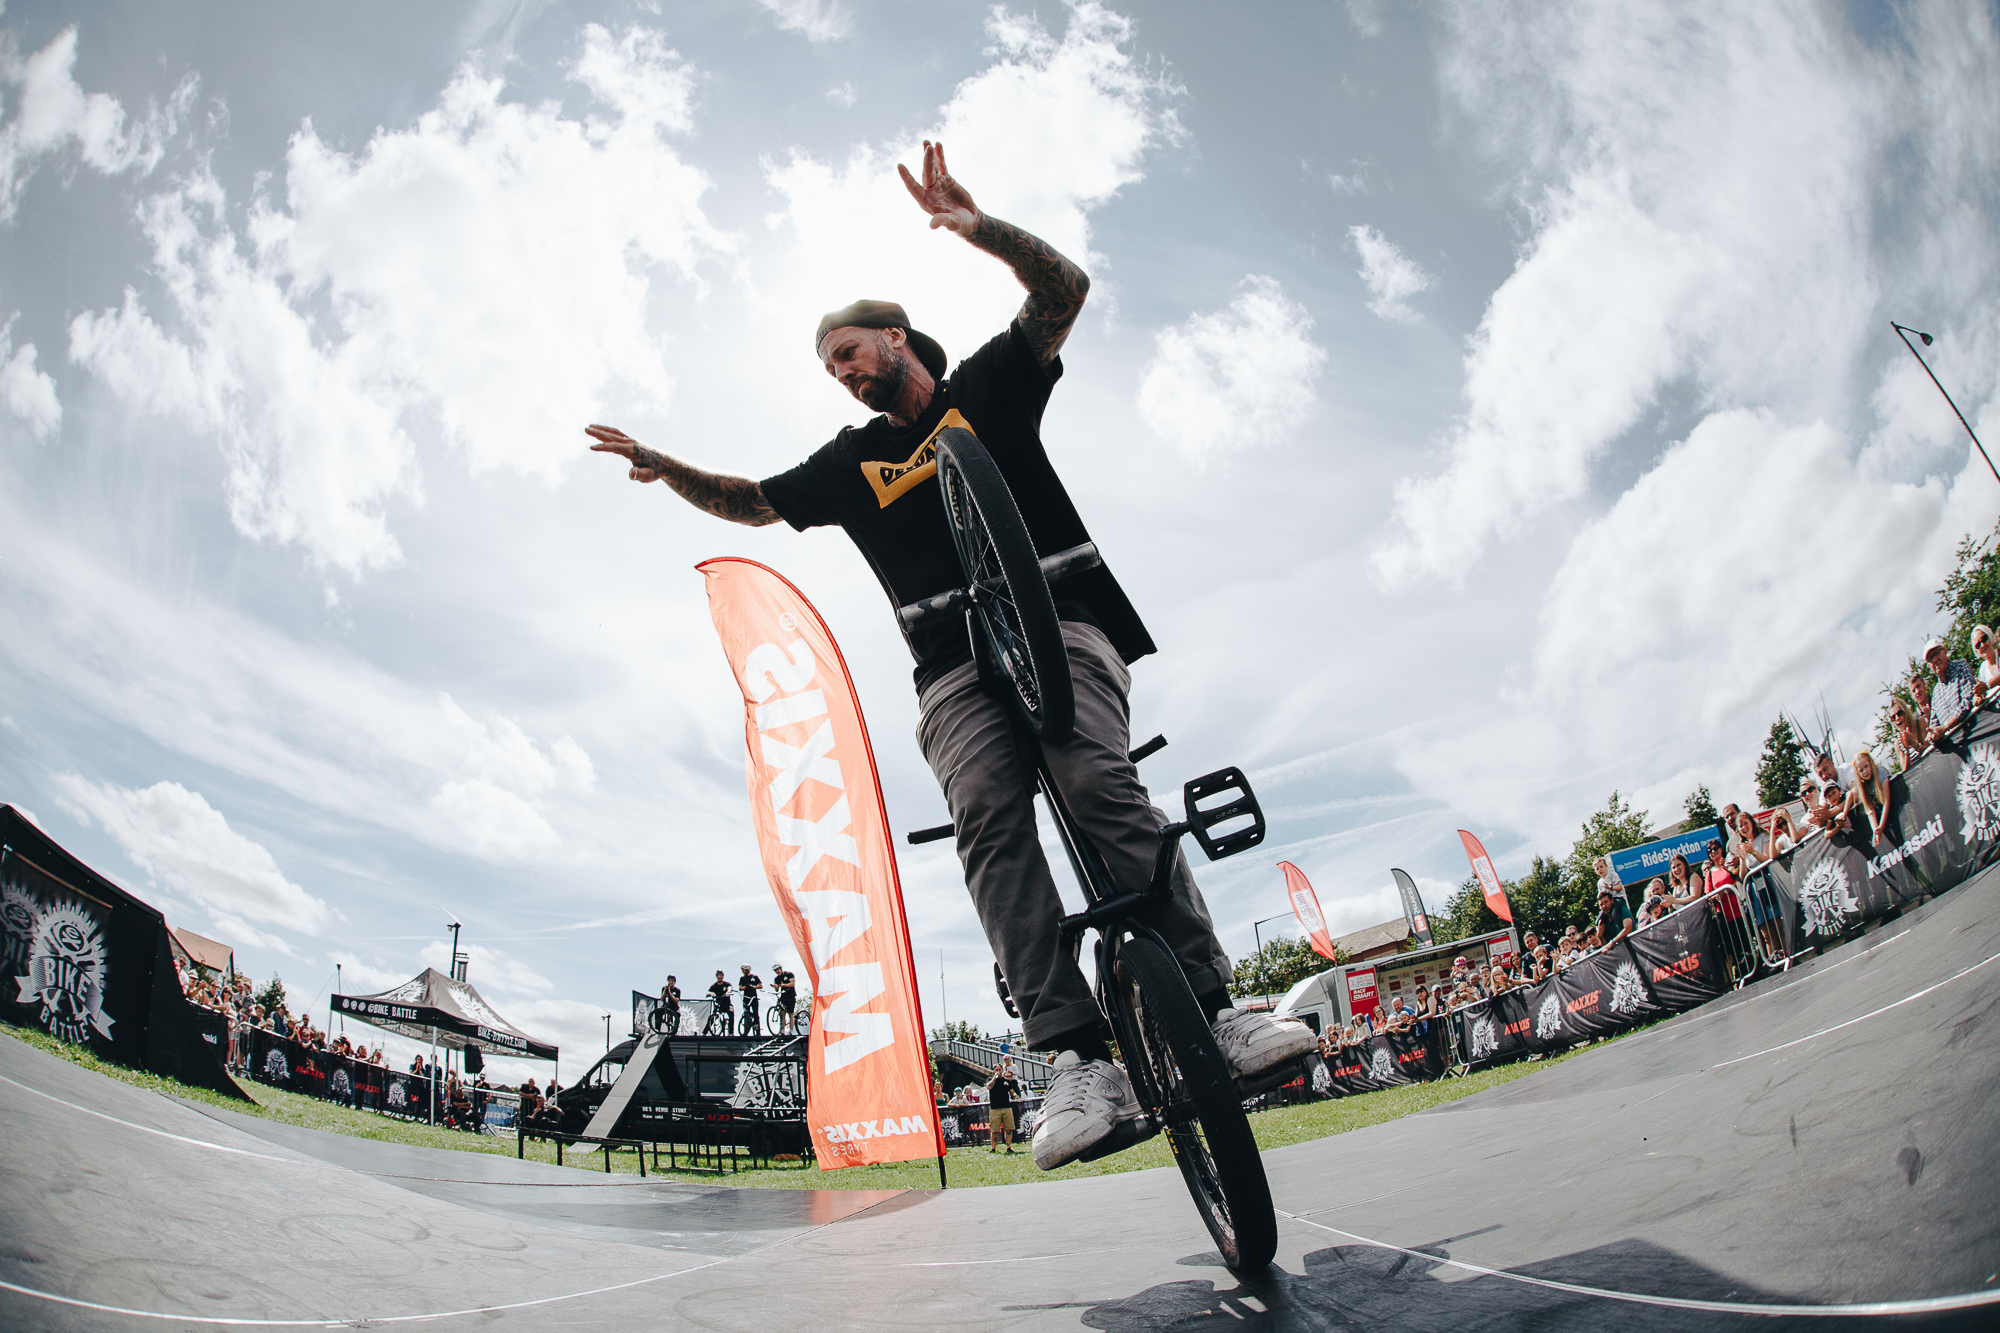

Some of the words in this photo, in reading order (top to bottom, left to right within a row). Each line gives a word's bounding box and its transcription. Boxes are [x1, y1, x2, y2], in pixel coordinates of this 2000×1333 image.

[1969, 781, 1998, 816] BIKE
[1867, 813, 1945, 879] Kawasaki
[1810, 890, 1840, 917] BIKE
[1818, 914, 1847, 936] BATTLE
[1385, 961, 1403, 969] MAKE
[1413, 955, 1434, 964] COUNT
[1653, 953, 1699, 983] MAXXIS
[44, 957, 91, 1002] BIKE
[1353, 990, 1374, 1001] SMART
[1565, 990, 1599, 1014] MAXXIS
[1582, 1004, 1600, 1017] TYRES
[40, 1004, 91, 1044] BATTLE
[355, 1082, 380, 1094] MAXXIS
